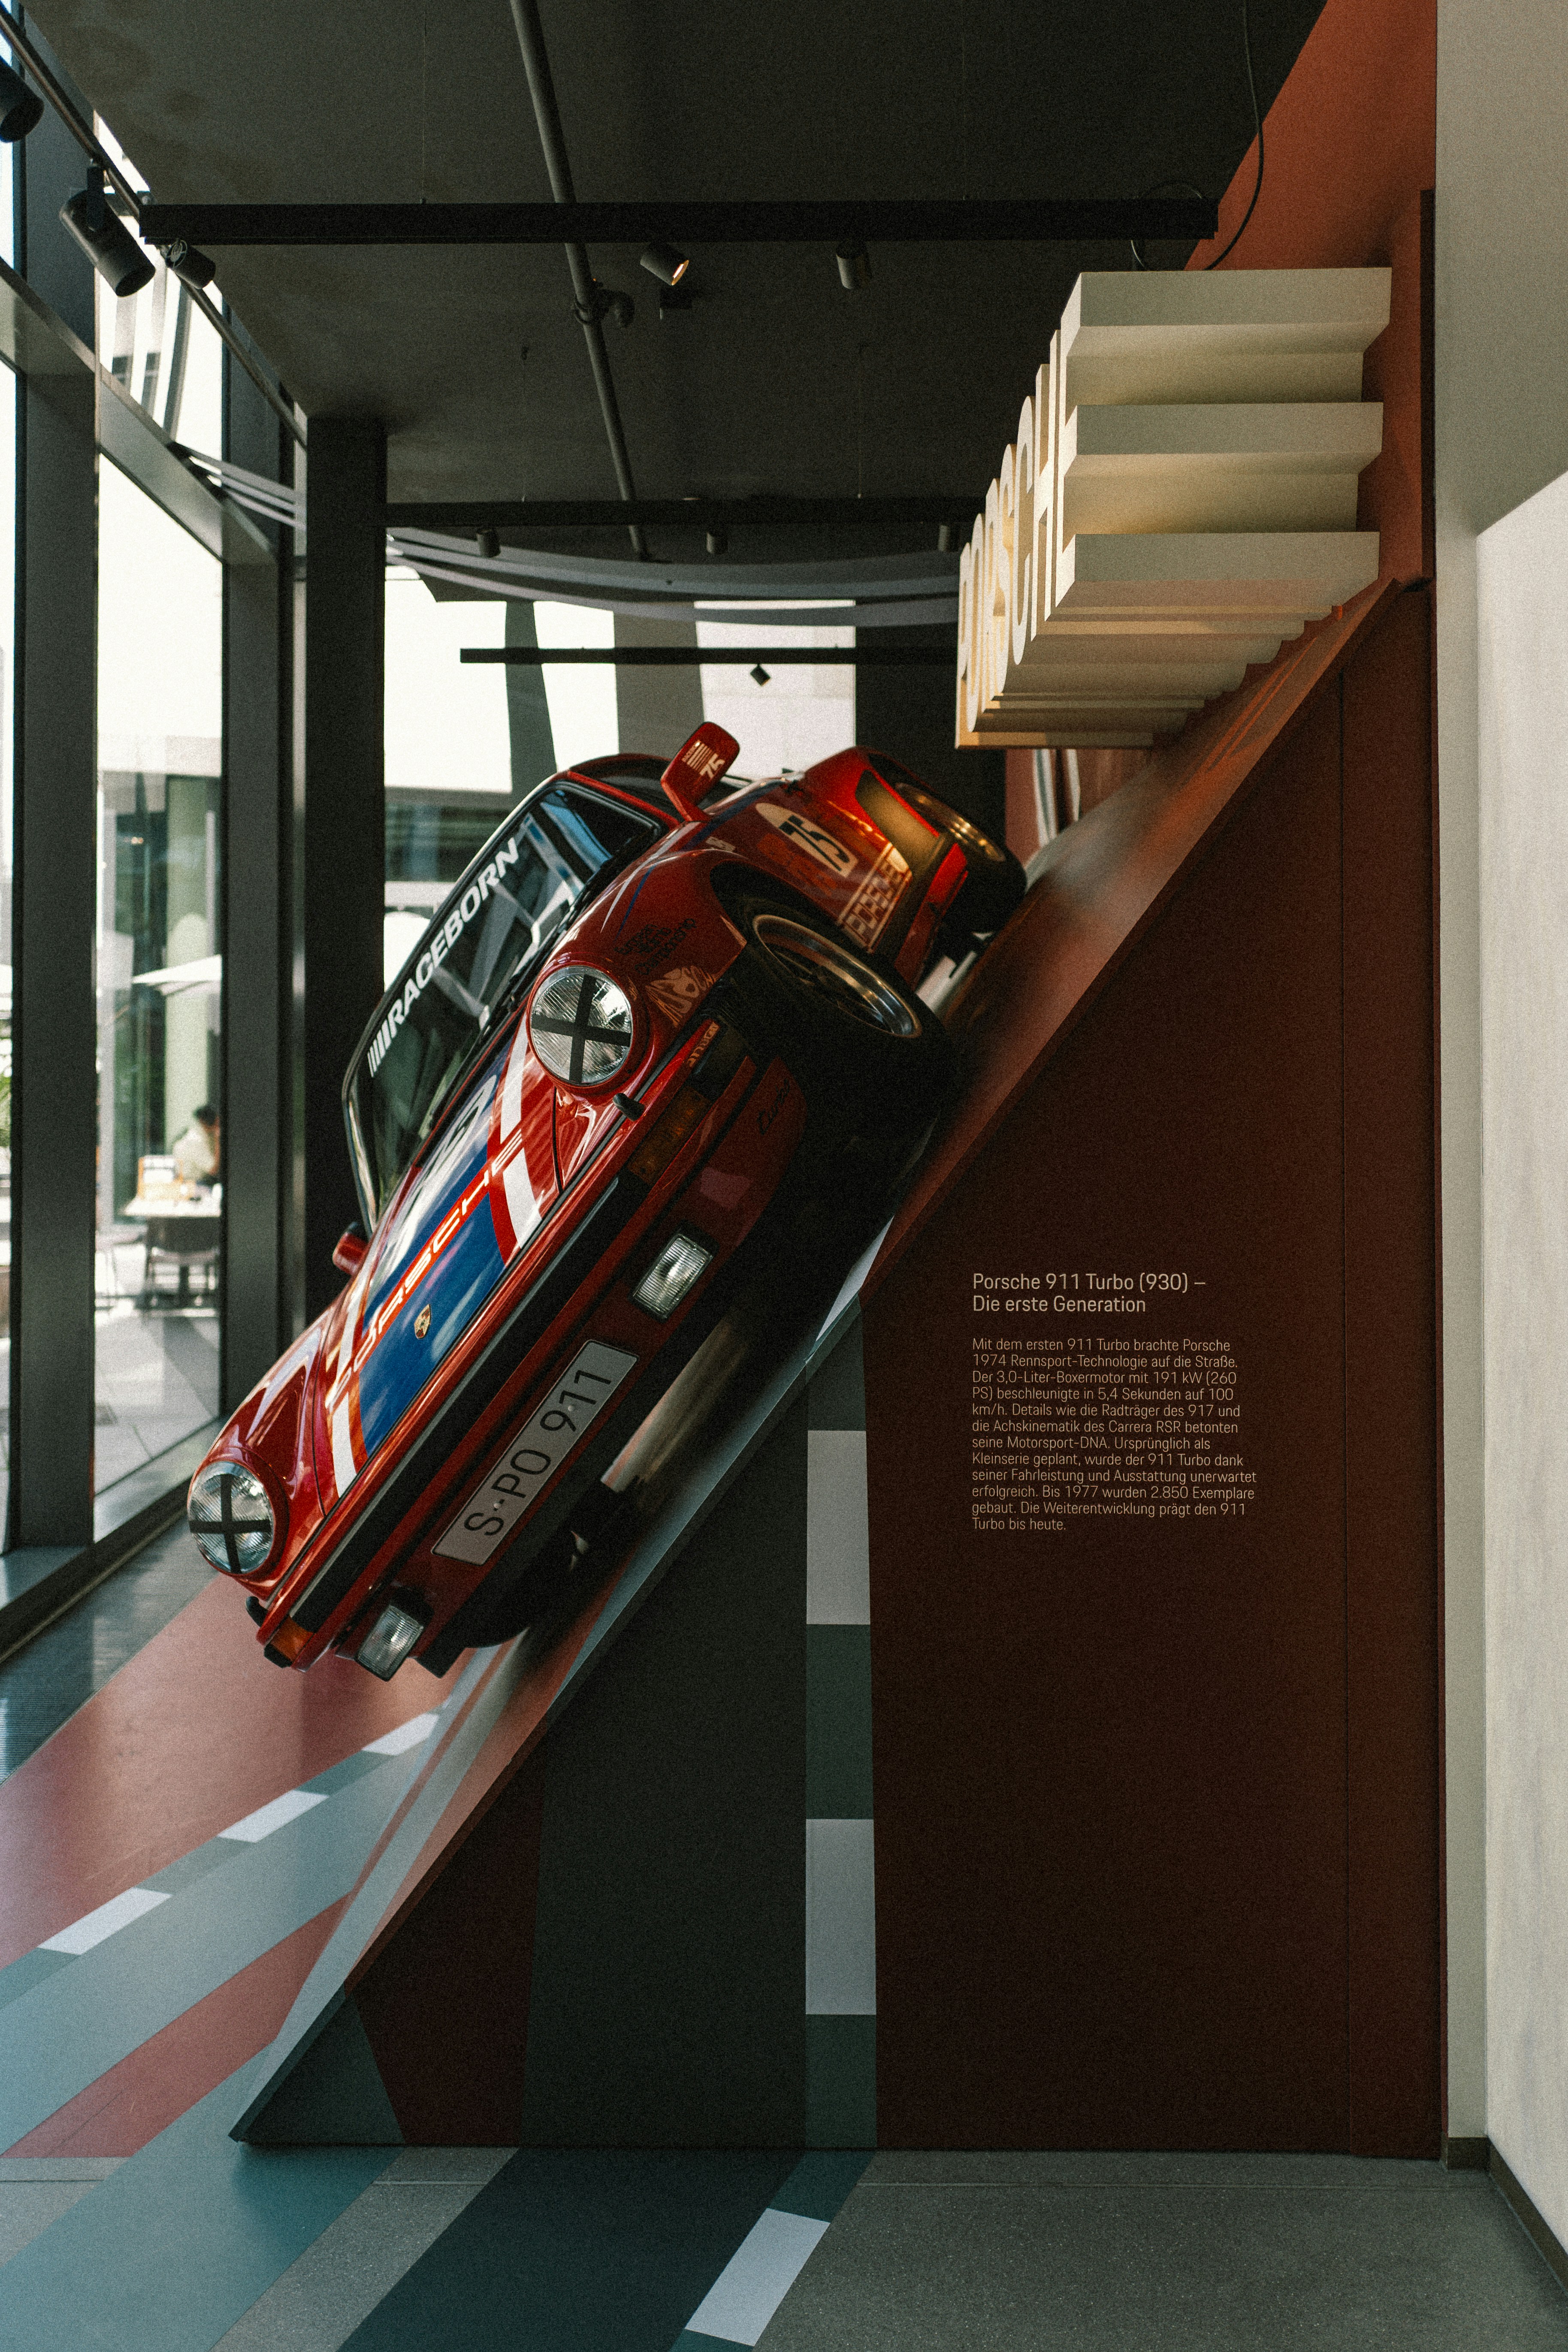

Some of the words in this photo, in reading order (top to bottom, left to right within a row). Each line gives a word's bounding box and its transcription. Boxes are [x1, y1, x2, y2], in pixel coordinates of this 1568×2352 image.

[700, 753, 725, 779] 75
[779, 815, 850, 872] 75
[387, 837, 520, 1039] RACEBORN
[613, 924, 658, 955] European
[634, 918, 697, 975] Championship
[325, 1128, 522, 1413] PORSCHE
[973, 1273, 1040, 1289] Porsche
[1045, 1273, 1079, 1289] 911
[1085, 1273, 1134, 1290] Turbo
[1139, 1272, 1188, 1294] (930)
[973, 1295, 1000, 1312] Die
[1005, 1297, 1048, 1312] erste
[1053, 1295, 1146, 1312] Generation
[973, 1338, 992, 1350] Mit
[996, 1338, 1022, 1350] dem
[1026, 1340, 1063, 1350] ersten
[1067, 1338, 1091, 1350] 911
[1096, 1338, 1130, 1351] Turbo
[1134, 1338, 1179, 1351] brachte
[1183, 1338, 1230, 1352] Porsche
[973, 1353, 1006, 1366] 1974
[1011, 1354, 1148, 1371] Rennsport-Technologie
[1151, 1355, 1170, 1368] auf
[1174, 1355, 1191, 1368] die
[1195, 1355, 1238, 1368] Straße.
[973, 1370, 993, 1383] Der
[997, 1370, 1125, 1384] 3,0-Liter-Boxermotor
[1129, 1371, 1148, 1384] mit
[1154, 1371, 1176, 1384] 191
[1182, 1371, 1202, 1383] kW
[1206, 1371, 1237, 1386] (260
[540, 1370, 612, 1432] 911
[973, 1386, 993, 1401] PS)
[997, 1387, 1079, 1402] beschleunigte
[1084, 1387, 1094, 1399] in
[1098, 1387, 1118, 1401] 5,4
[1122, 1387, 1181, 1400] Sekunden
[1185, 1388, 1205, 1400] auf
[1209, 1388, 1234, 1401] 100
[972, 1403, 1007, 1416] km/h.
[1012, 1403, 1052, 1416] Details
[1055, 1404, 1076, 1416] wie
[1080, 1404, 1097, 1416] die
[1102, 1404, 1160, 1419] Radträger
[1163, 1404, 1184, 1417] des
[1188, 1404, 1214, 1416] 917
[1218, 1404, 1240, 1417] und
[972, 1419, 989, 1432] die
[993, 1419, 1080, 1432] Achskinematik
[1084, 1420, 1105, 1432] des
[1109, 1420, 1152, 1433] Carrera
[1156, 1420, 1181, 1433] RSR
[1185, 1421, 1238, 1434] betonten
[972, 1435, 1003, 1448] seine
[1007, 1436, 1111, 1451] Motorsport-DNA.
[1115, 1437, 1190, 1452] Ursprünglich
[1194, 1437, 1211, 1449] als
[973, 1452, 1029, 1464] Kleinserie
[1033, 1452, 1081, 1467] geplant,
[1085, 1453, 1121, 1465] wurde
[1125, 1453, 1145, 1466] der
[1148, 1453, 1172, 1466] 911
[1177, 1453, 1211, 1466] Turbo
[1215, 1454, 1244, 1466] dank
[972, 1468, 1008, 1481] seiner
[1012, 1468, 1084, 1484] Fahrleistung
[1088, 1469, 1110, 1482] und
[1114, 1469, 1186, 1485] Ausstattung
[1190, 1472, 1257, 1483] unerwartet
[972, 1485, 1038, 1500] erfolgreich.
[1042, 1485, 1060, 1498] Bis
[1065, 1485, 1099, 1498] 1977
[1103, 1485, 1147, 1498] wurden
[1151, 1485, 1188, 1499] 2.850
[1193, 1486, 1254, 1502] Exemplare
[972, 1501, 1017, 1516] gebaut.
[1021, 1501, 1039, 1514] Die
[1043, 1501, 1155, 1518] Weiterentwicklung
[1159, 1502, 1191, 1519] prägt
[1194, 1503, 1216, 1516] den
[1221, 1503, 1245, 1516] 911
[972, 1517, 1005, 1530] Turbo
[1009, 1518, 1026, 1530] bis
[1030, 1518, 1066, 1531] heute.
